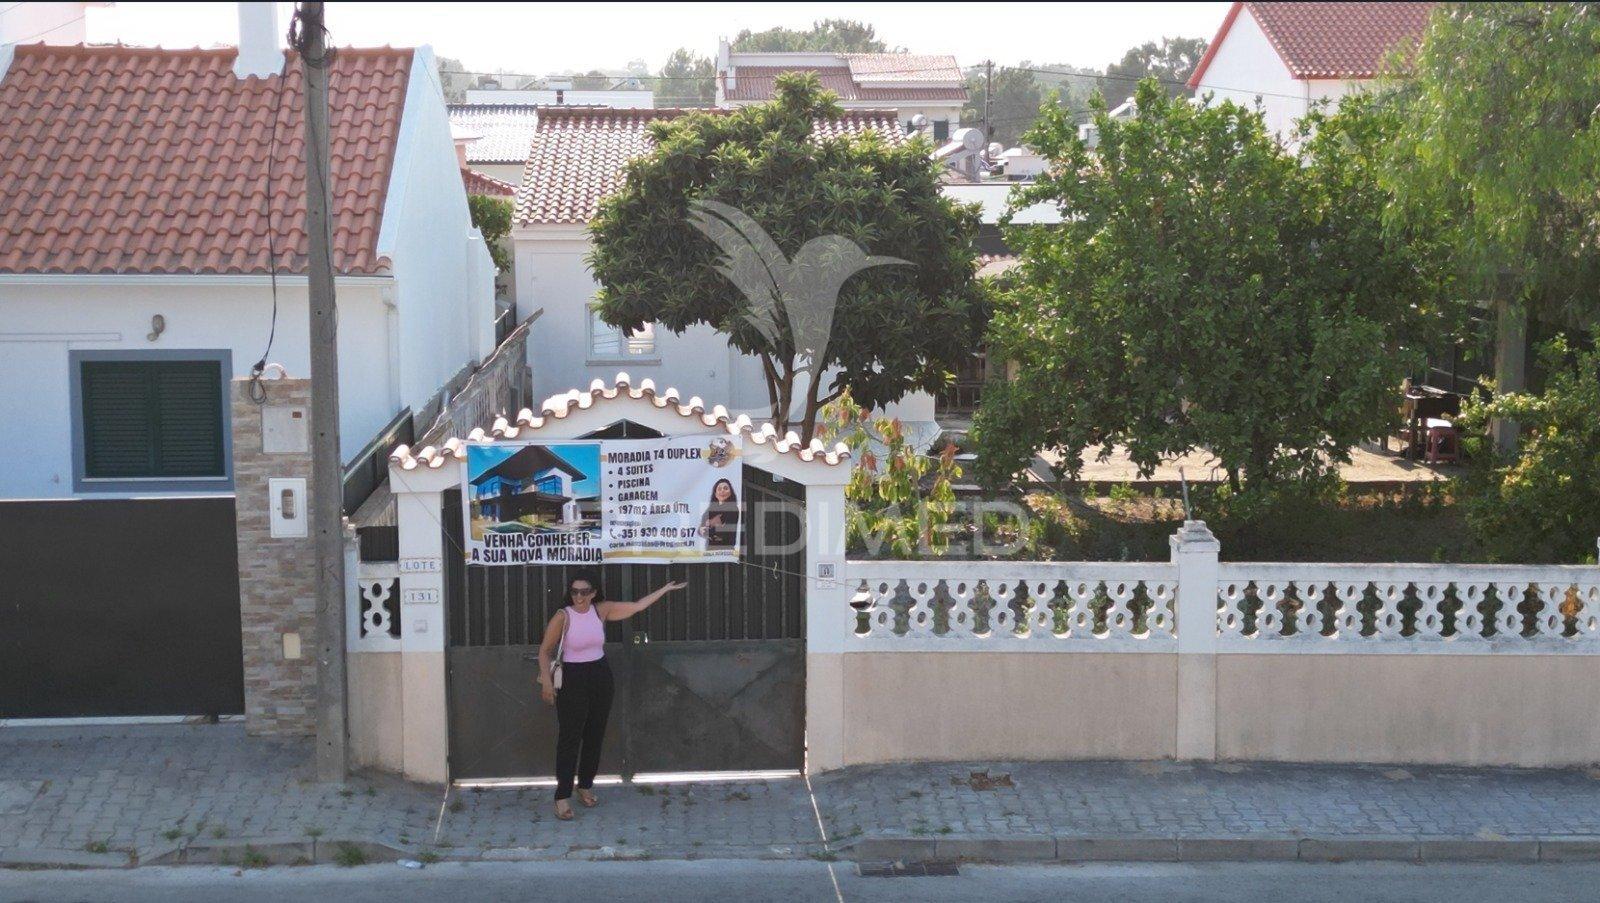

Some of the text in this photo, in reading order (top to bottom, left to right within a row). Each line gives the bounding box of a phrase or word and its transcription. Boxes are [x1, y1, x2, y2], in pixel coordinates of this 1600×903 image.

[607, 448, 701, 463] MORADIA T4 DUPLEX
[617, 464, 654, 476] 4 SUITES
[617, 477, 650, 489] PISCINA
[618, 491, 658, 501] GARAGEM
[650, 502, 671, 514] ÁREA
[673, 501, 690, 514] ÚTIL
[640, 526, 657, 538] 930
[660, 526, 678, 538] 400
[680, 527, 696, 538] 617
[484, 532, 590, 547] VENHA CONHECER
[472, 547, 603, 562] A SUA NOVA MORADIA
[405, 561, 436, 570] LOTE
[411, 592, 431, 600] 131
